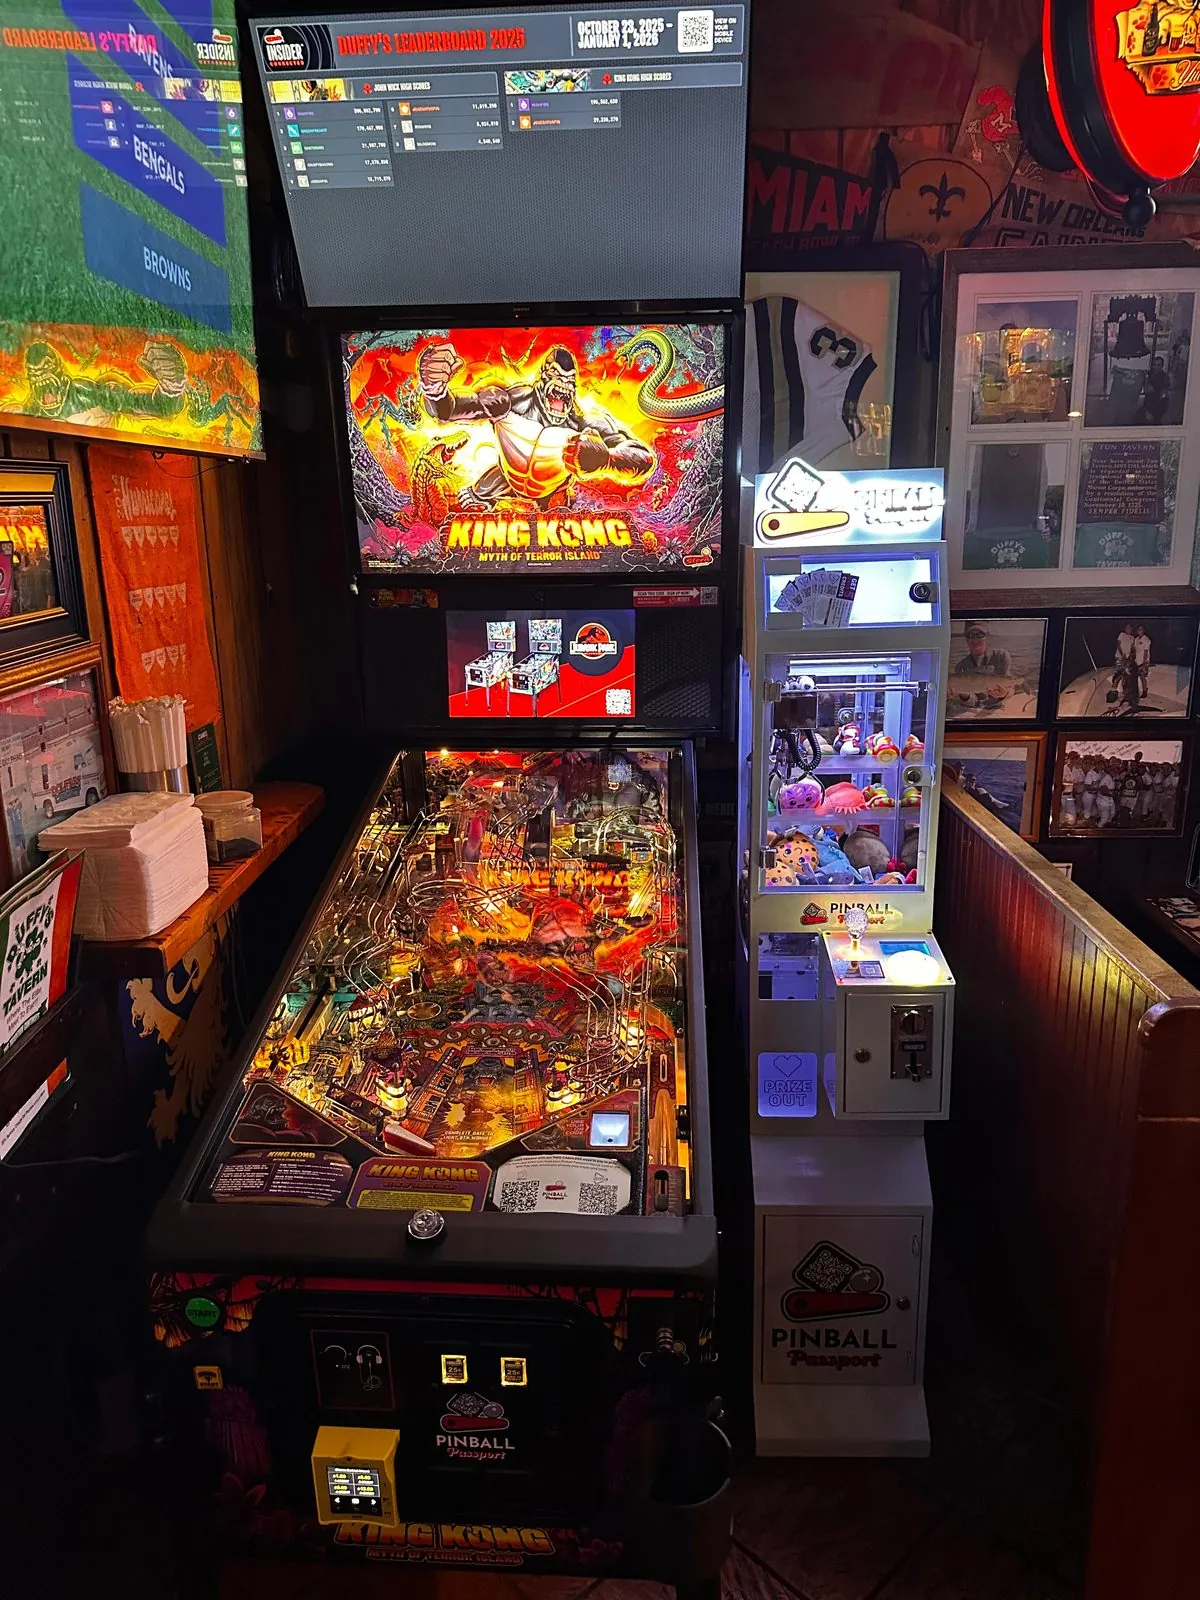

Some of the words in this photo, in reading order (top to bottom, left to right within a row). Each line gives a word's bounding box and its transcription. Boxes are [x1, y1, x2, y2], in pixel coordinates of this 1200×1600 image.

[577, 19, 620, 36] OCTOBER
[621, 19, 638, 35] 23,
[639, 17, 665, 34] 2025
[337, 31, 392, 57] DUFFY'S
[393, 28, 487, 54] LEADERBOARD
[489, 27, 525, 50] 2025
[578, 33, 621, 49] JANUARY
[265, 43, 304, 62] INSIDER
[413, 81, 431, 90] SCORES
[613, 74, 626, 83] KING
[626, 73, 640, 82] KONG
[640, 73, 653, 82] HIGH
[653, 72, 672, 81] SCORES
[133, 134, 187, 195] BENGALS
[1001, 182, 1064, 226] NEW
[143, 246, 192, 292] BROWNS
[446, 519, 531, 549] KING
[537, 518, 633, 548] KONG
[478, 552, 506, 562] MYTH
[510, 552, 523, 561] OF
[525, 552, 564, 562] TERROR
[564, 551, 601, 561] ISLAND
[6, 896, 55, 964] DUFFY'S
[3, 961, 49, 1017] TAVERN
[763, 1079, 813, 1094] PRIZE
[768, 1093, 808, 1108] OUT
[290, 1151, 316, 1159] KONG
[366, 1163, 420, 1180] KING
[421, 1165, 480, 1182] KONG
[187, 1309, 217, 1319] START
[771, 1327, 898, 1349] PINBALL
[786, 1350, 882, 1371] Passport
[435, 1434, 516, 1450] PINBALL
[447, 1447, 507, 1461] Passport
[335, 1521, 434, 1546] KING
[440, 1522, 552, 1552] KONG
